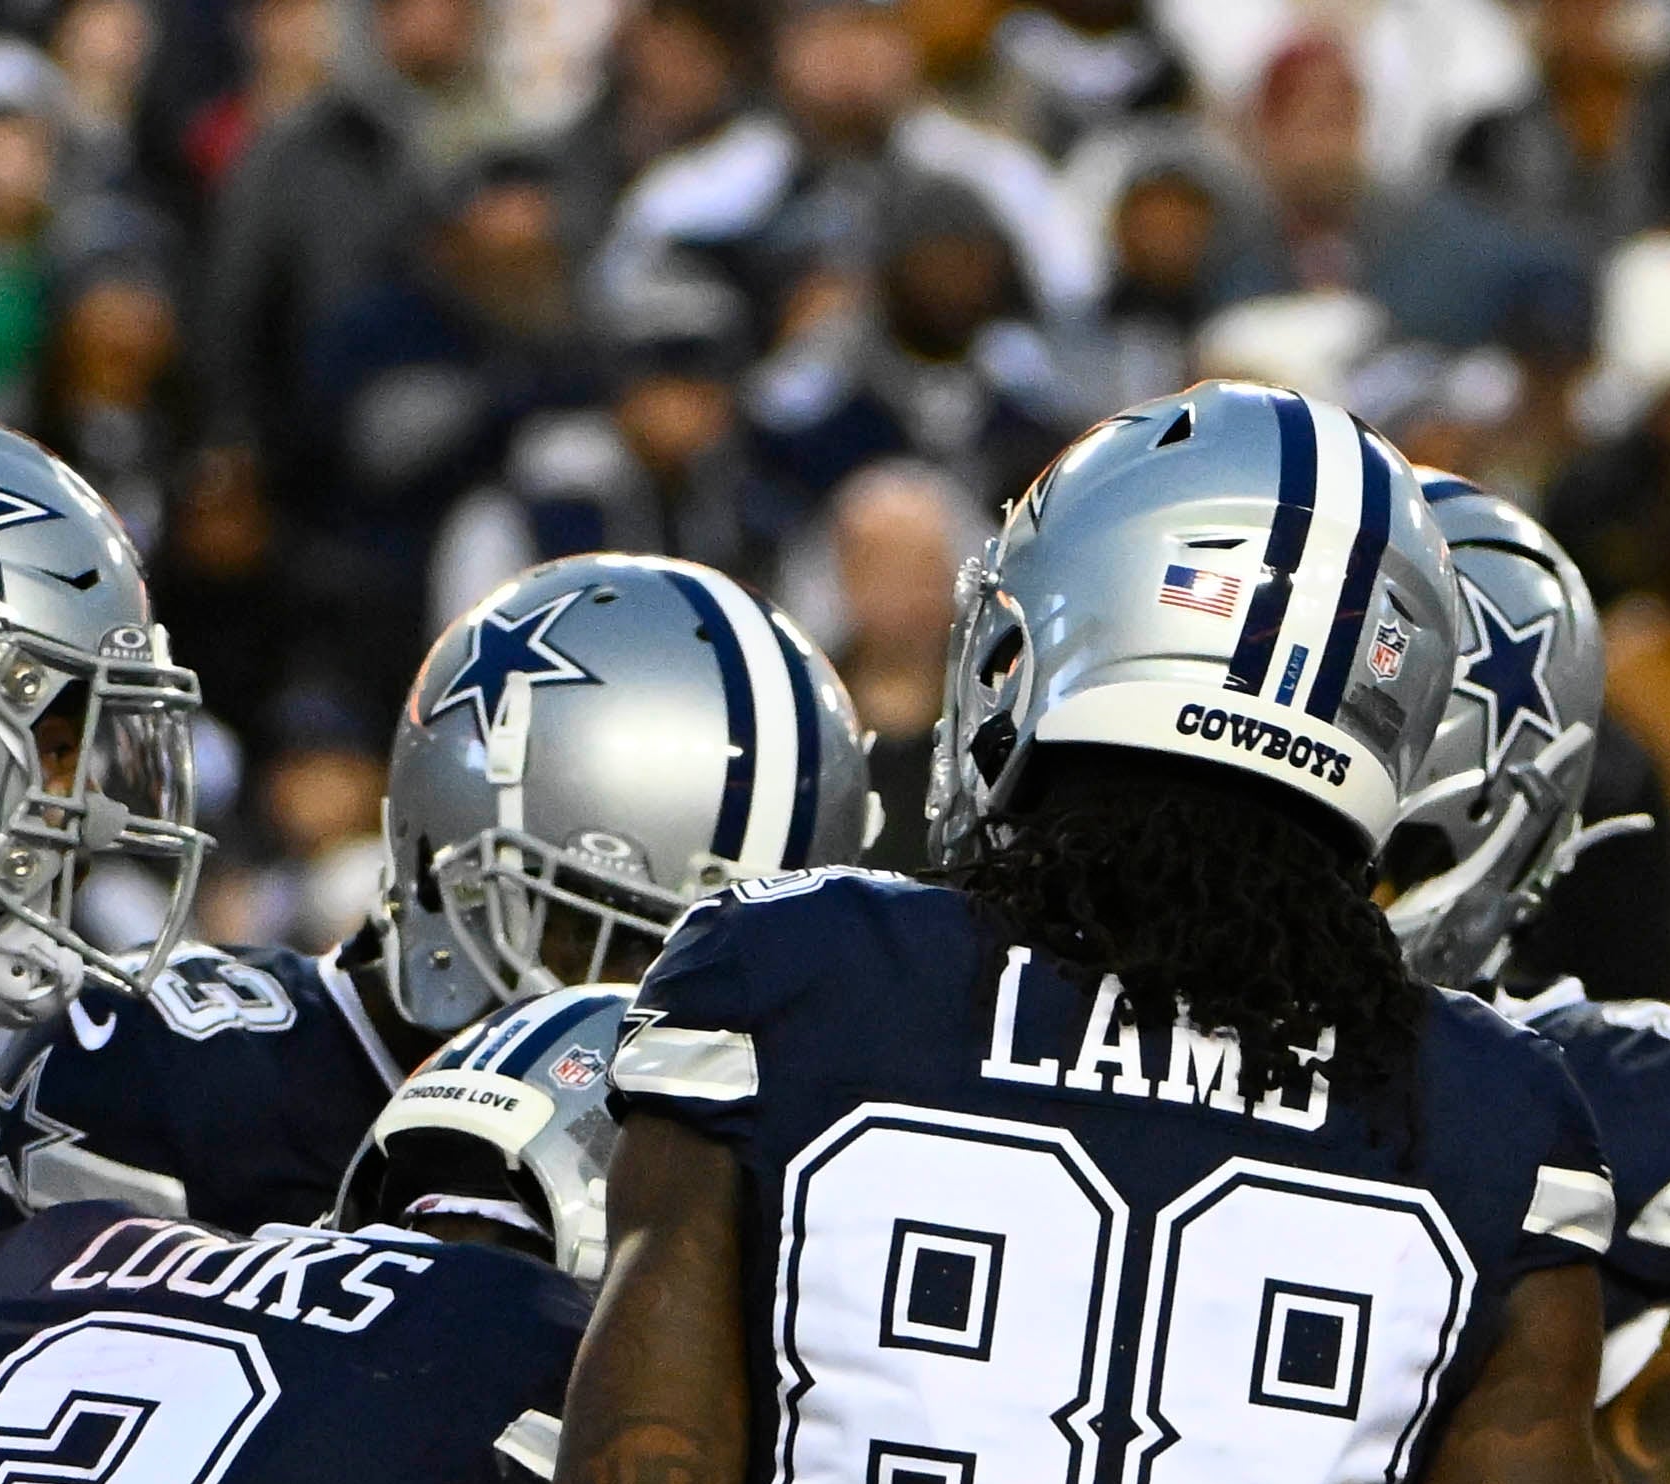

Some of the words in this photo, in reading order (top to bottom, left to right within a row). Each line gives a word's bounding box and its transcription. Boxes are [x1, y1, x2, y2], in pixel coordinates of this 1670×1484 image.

[1176, 703, 1352, 786] COWBOYS
[403, 1085, 466, 1100] CHOOSE
[468, 1089, 520, 1112] LOVE
[556, 1056, 596, 1085] NFL
[52, 1218, 434, 1332] COOKS
